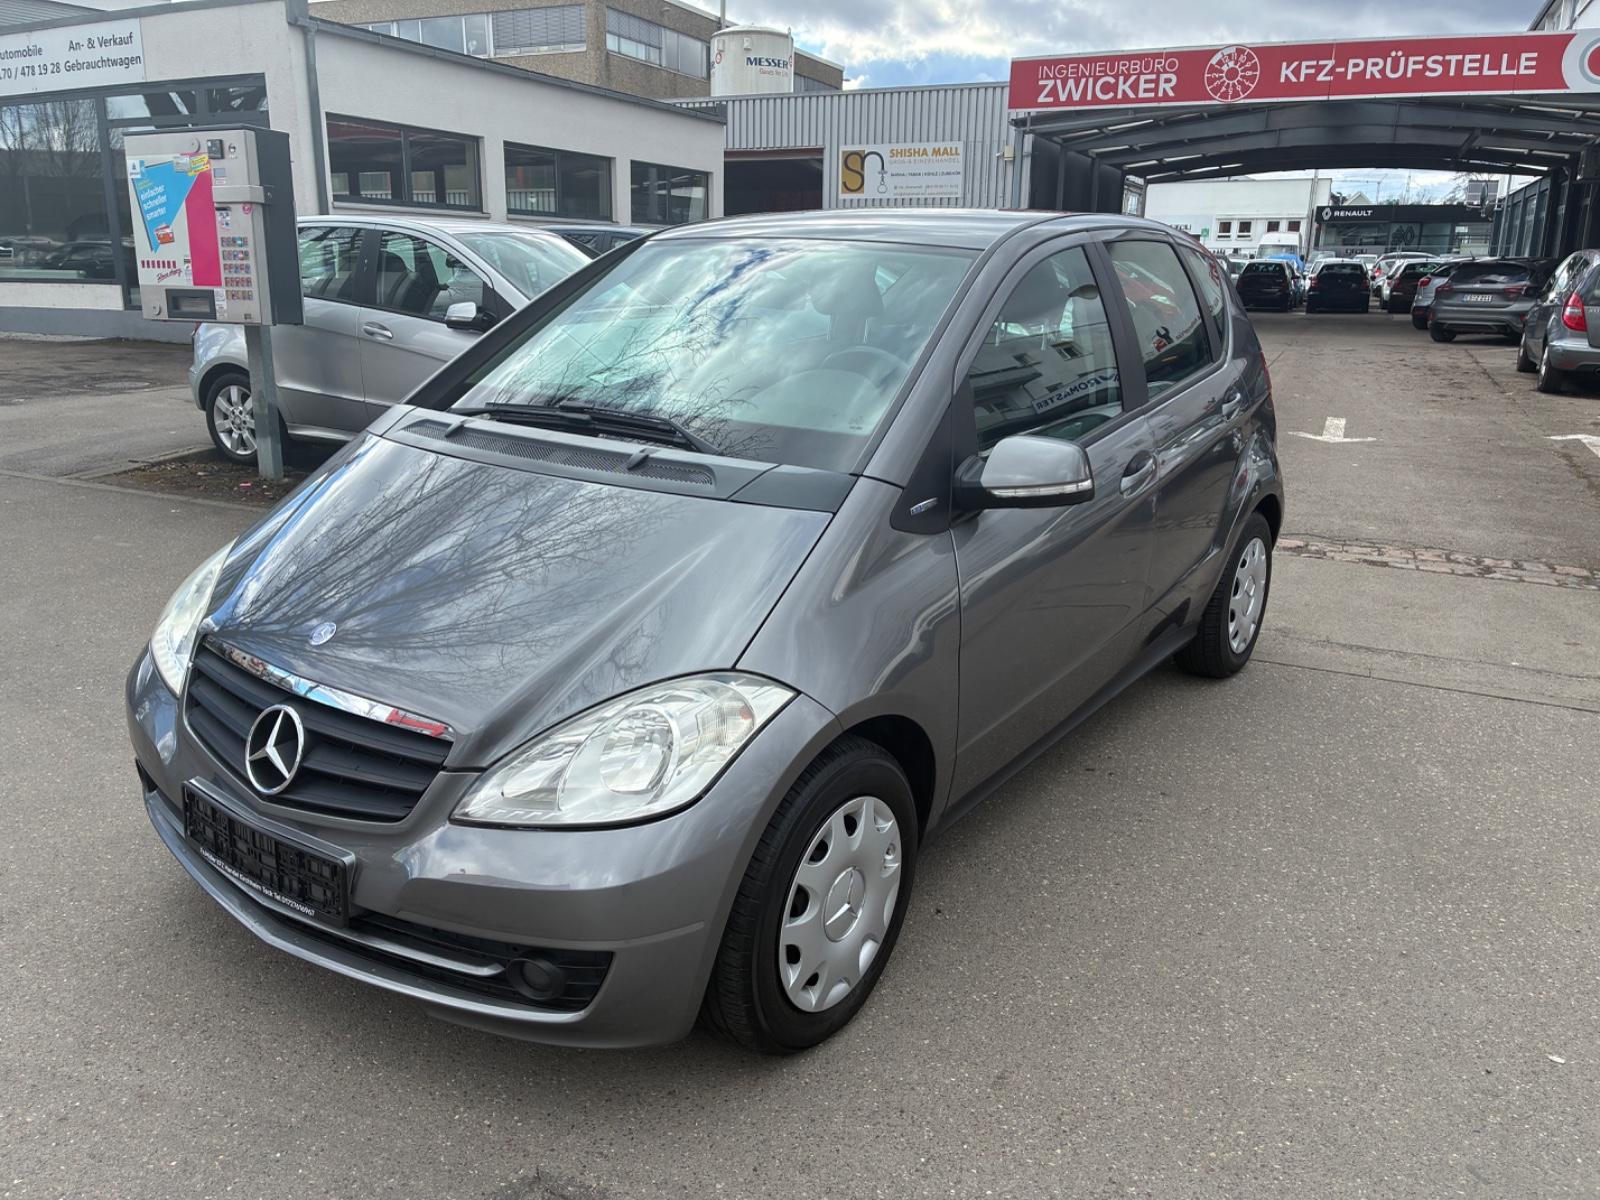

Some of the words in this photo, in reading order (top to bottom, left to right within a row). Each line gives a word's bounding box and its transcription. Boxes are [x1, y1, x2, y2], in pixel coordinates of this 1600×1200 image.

[68, 40, 84, 52] An-
[87, 37, 95, 49] &
[97, 31, 134, 48] Verkauf
[20, 64, 36, 77] 478
[38, 63, 48, 76] 19
[50, 61, 61, 74] 28
[64, 54, 142, 72] Gebrauchtwagen
[746, 56, 789, 70] MESSER
[1038, 57, 1179, 79] INGENIEURBÜRO
[1279, 49, 1538, 83] KFZ-PRÜFSTELLE
[1037, 73, 1177, 103] ZWICKER
[889, 147, 929, 159] SHISHA
[931, 146, 960, 158] MALL
